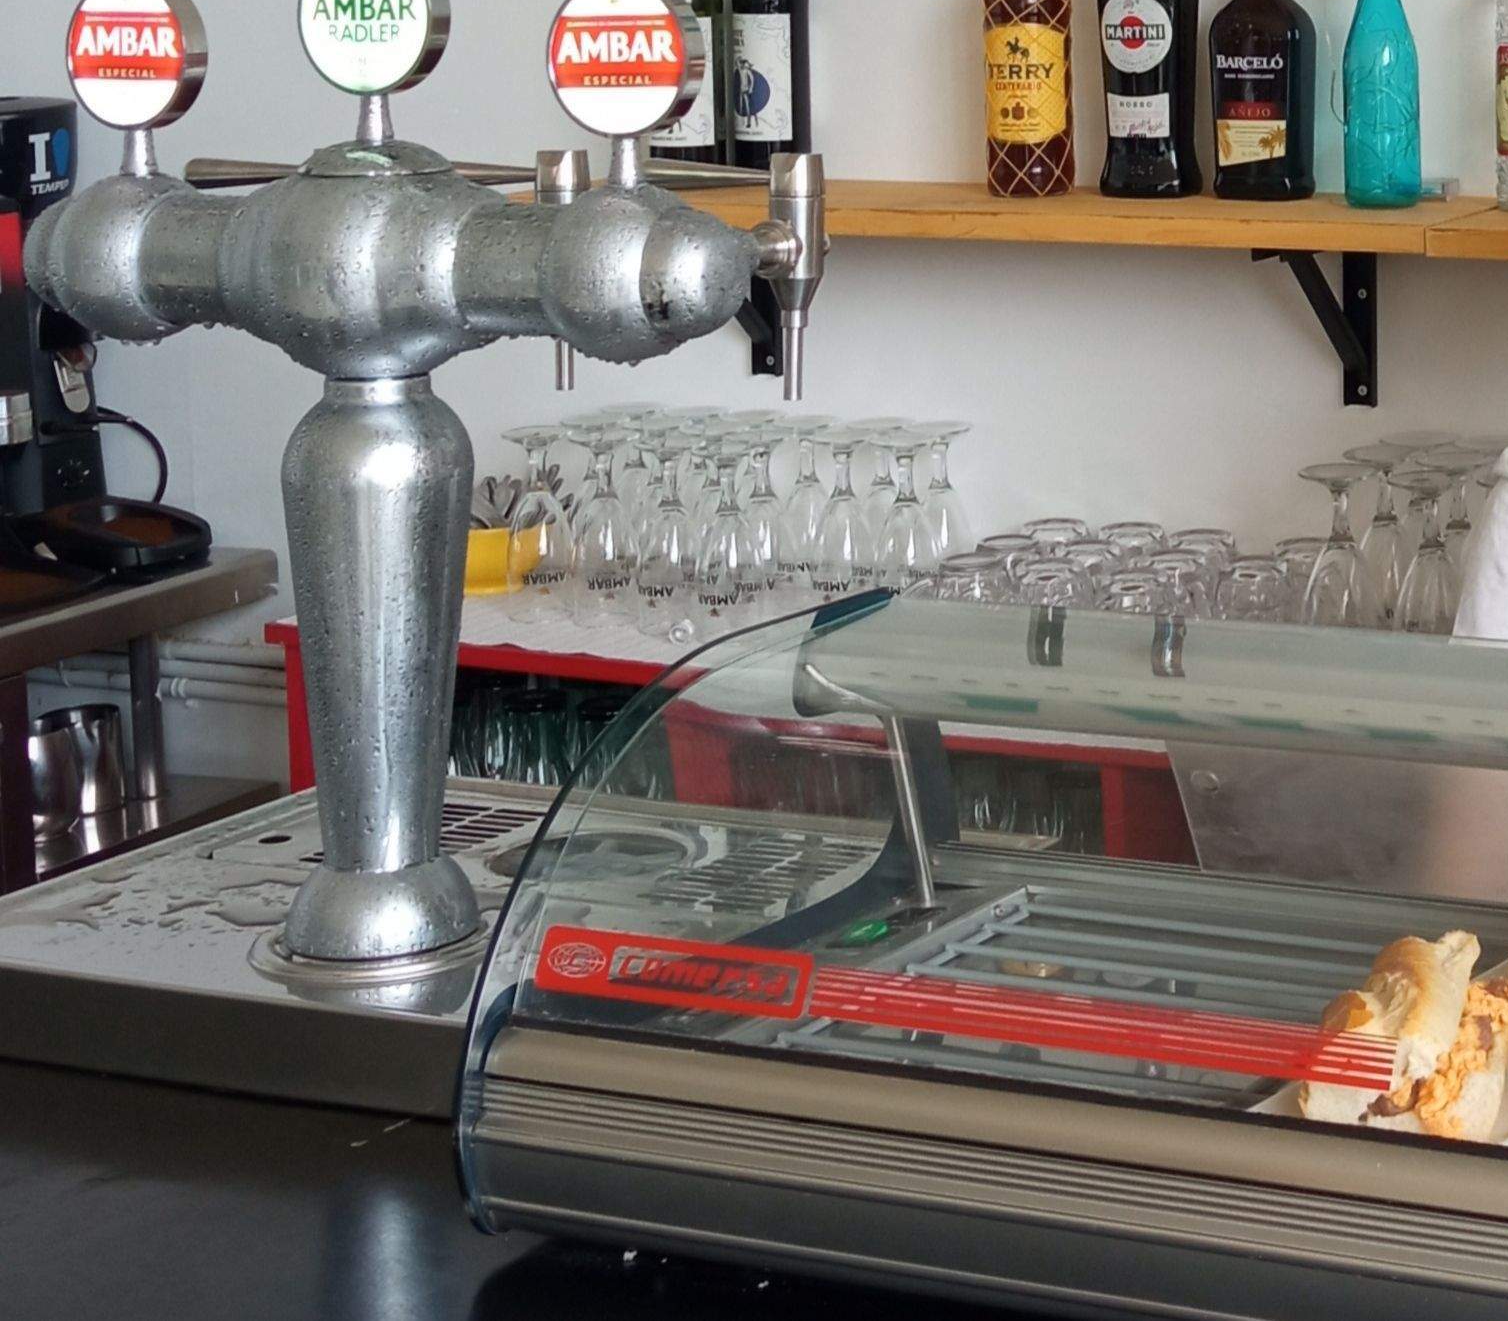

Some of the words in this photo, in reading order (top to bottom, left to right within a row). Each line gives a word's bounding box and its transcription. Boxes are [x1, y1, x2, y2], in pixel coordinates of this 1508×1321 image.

[328, 23, 400, 43] RADLER
[1105, 25, 1164, 40] MARTINI
[75, 25, 180, 58] AMBAR
[556, 29, 678, 64] AMBAR
[988, 62, 1054, 79] TERRY
[1216, 53, 1284, 71] BARCELÓ
[98, 67, 156, 78] ESPECIAL
[583, 74, 652, 86] ESPECIAL
[587, 575, 633, 591] AMBAR
